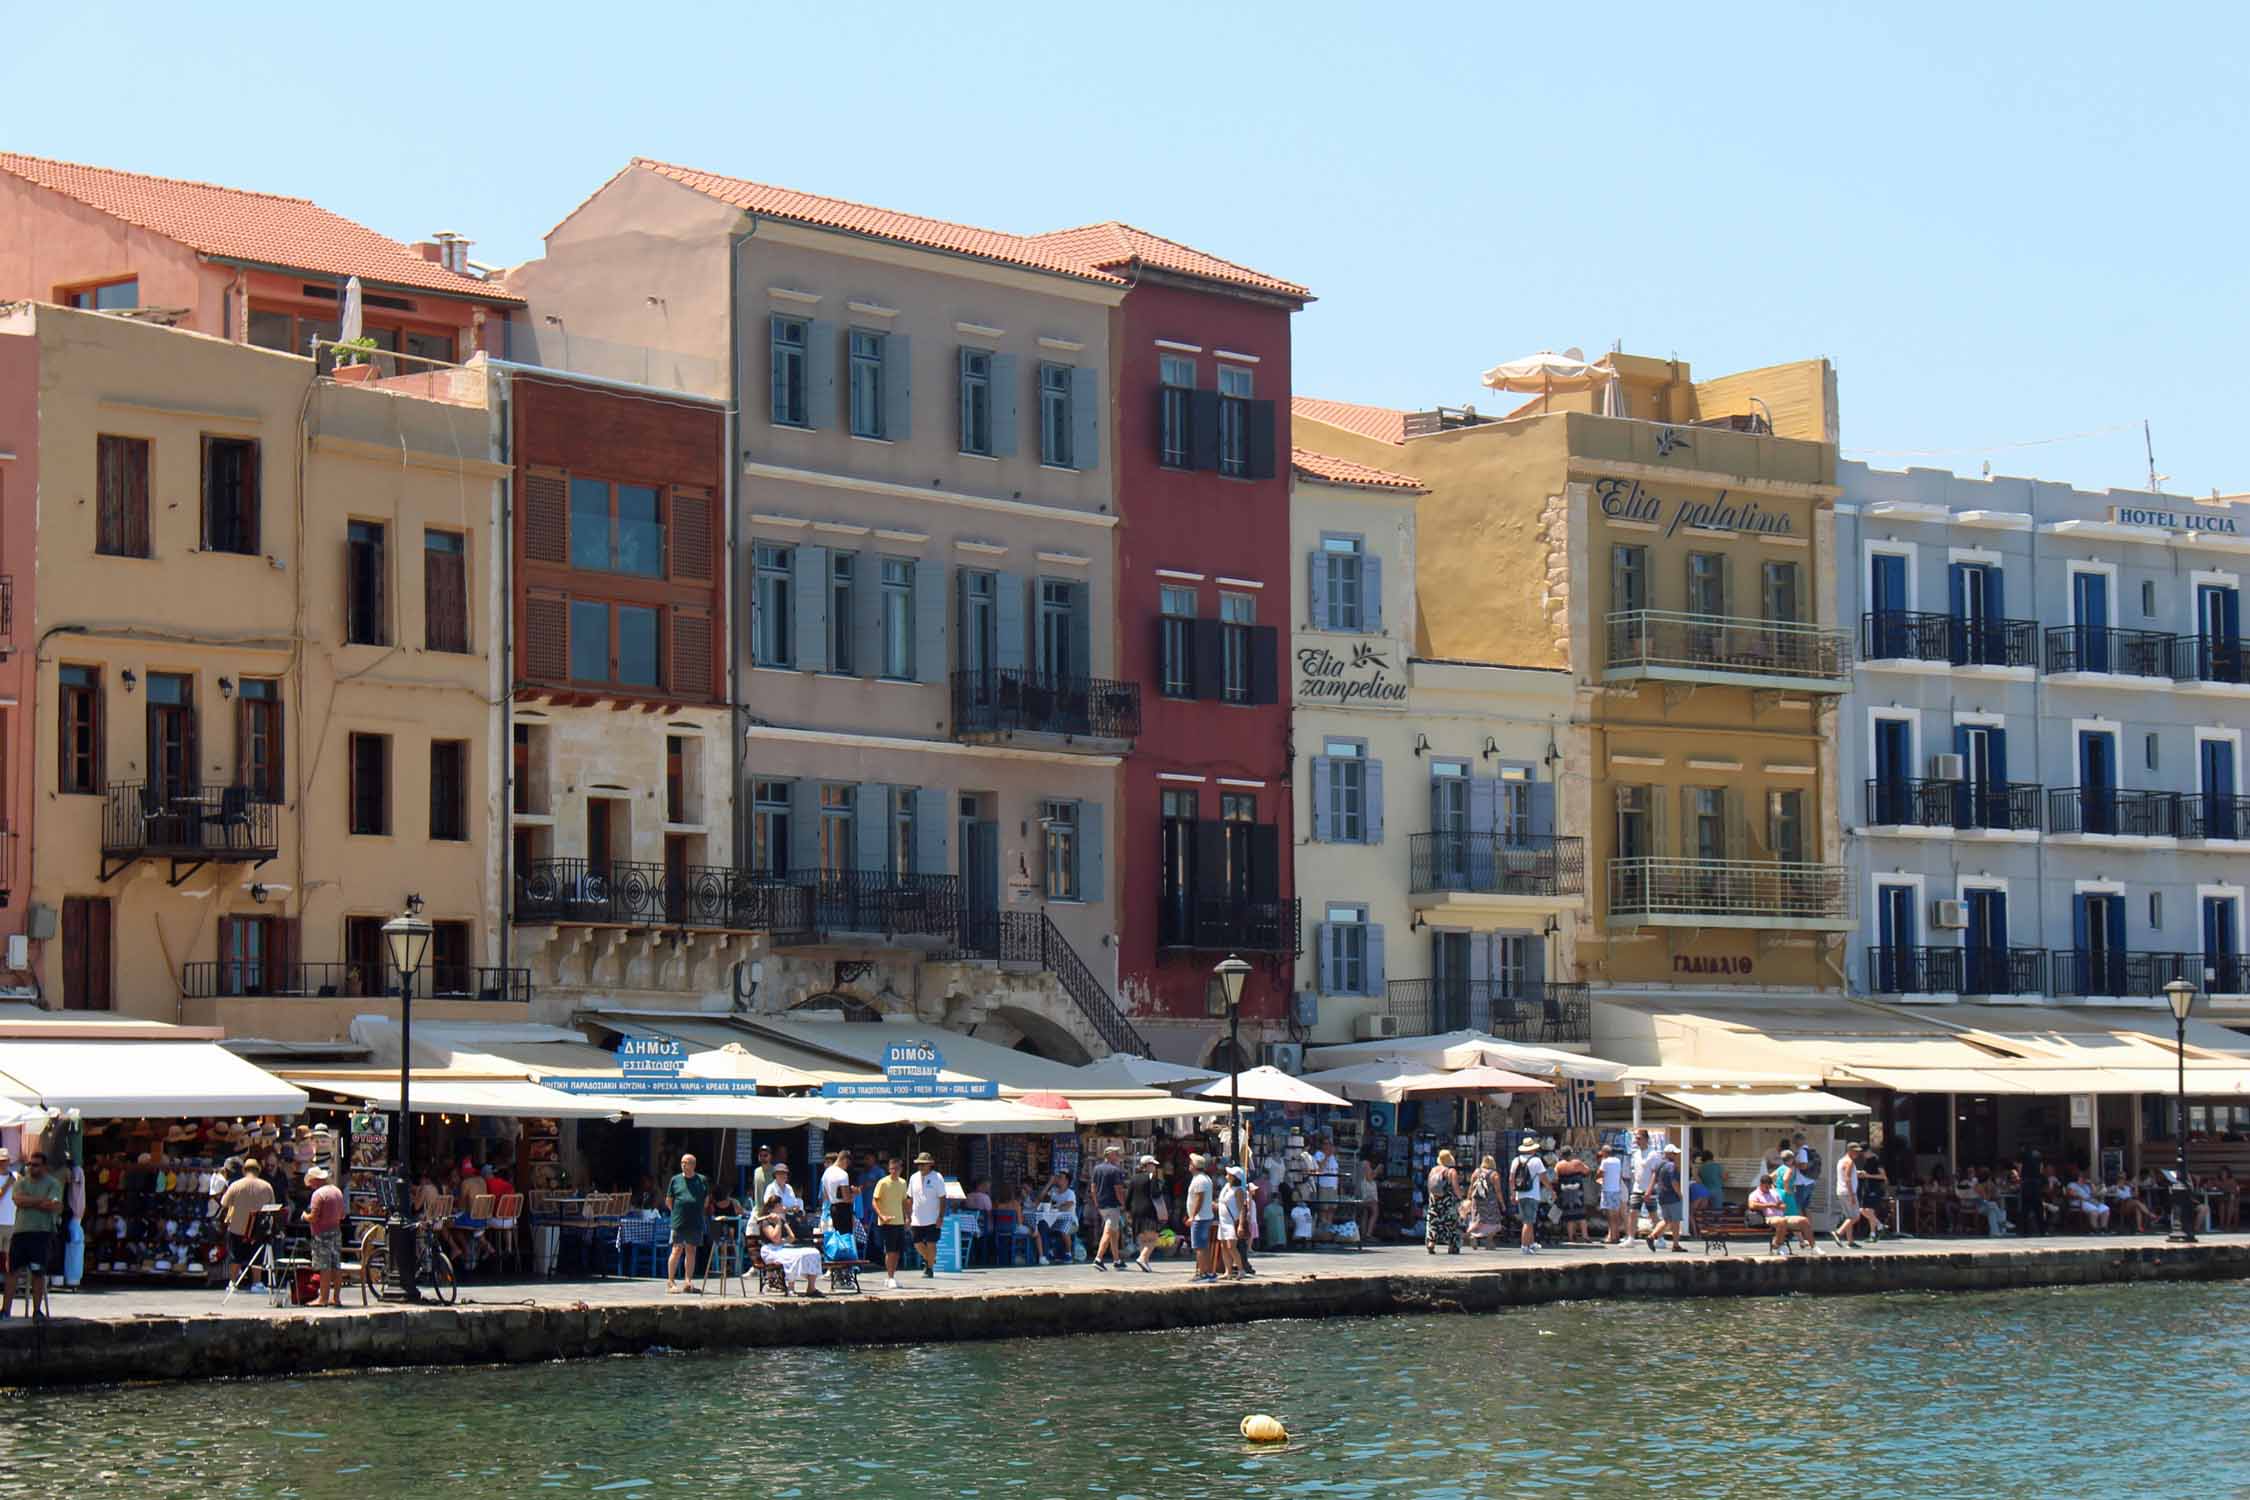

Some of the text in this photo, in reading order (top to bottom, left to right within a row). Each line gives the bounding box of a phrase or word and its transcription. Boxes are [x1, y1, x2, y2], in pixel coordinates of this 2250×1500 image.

[1595, 478, 1793, 538] Elia palatino
[2120, 508, 2236, 532] HOTEL LUCIA
[1297, 648, 1406, 703] Elia zampeliou
[624, 1041, 680, 1055] ΔΗΜΟΣ
[891, 1047, 935, 1061] DIMOS
